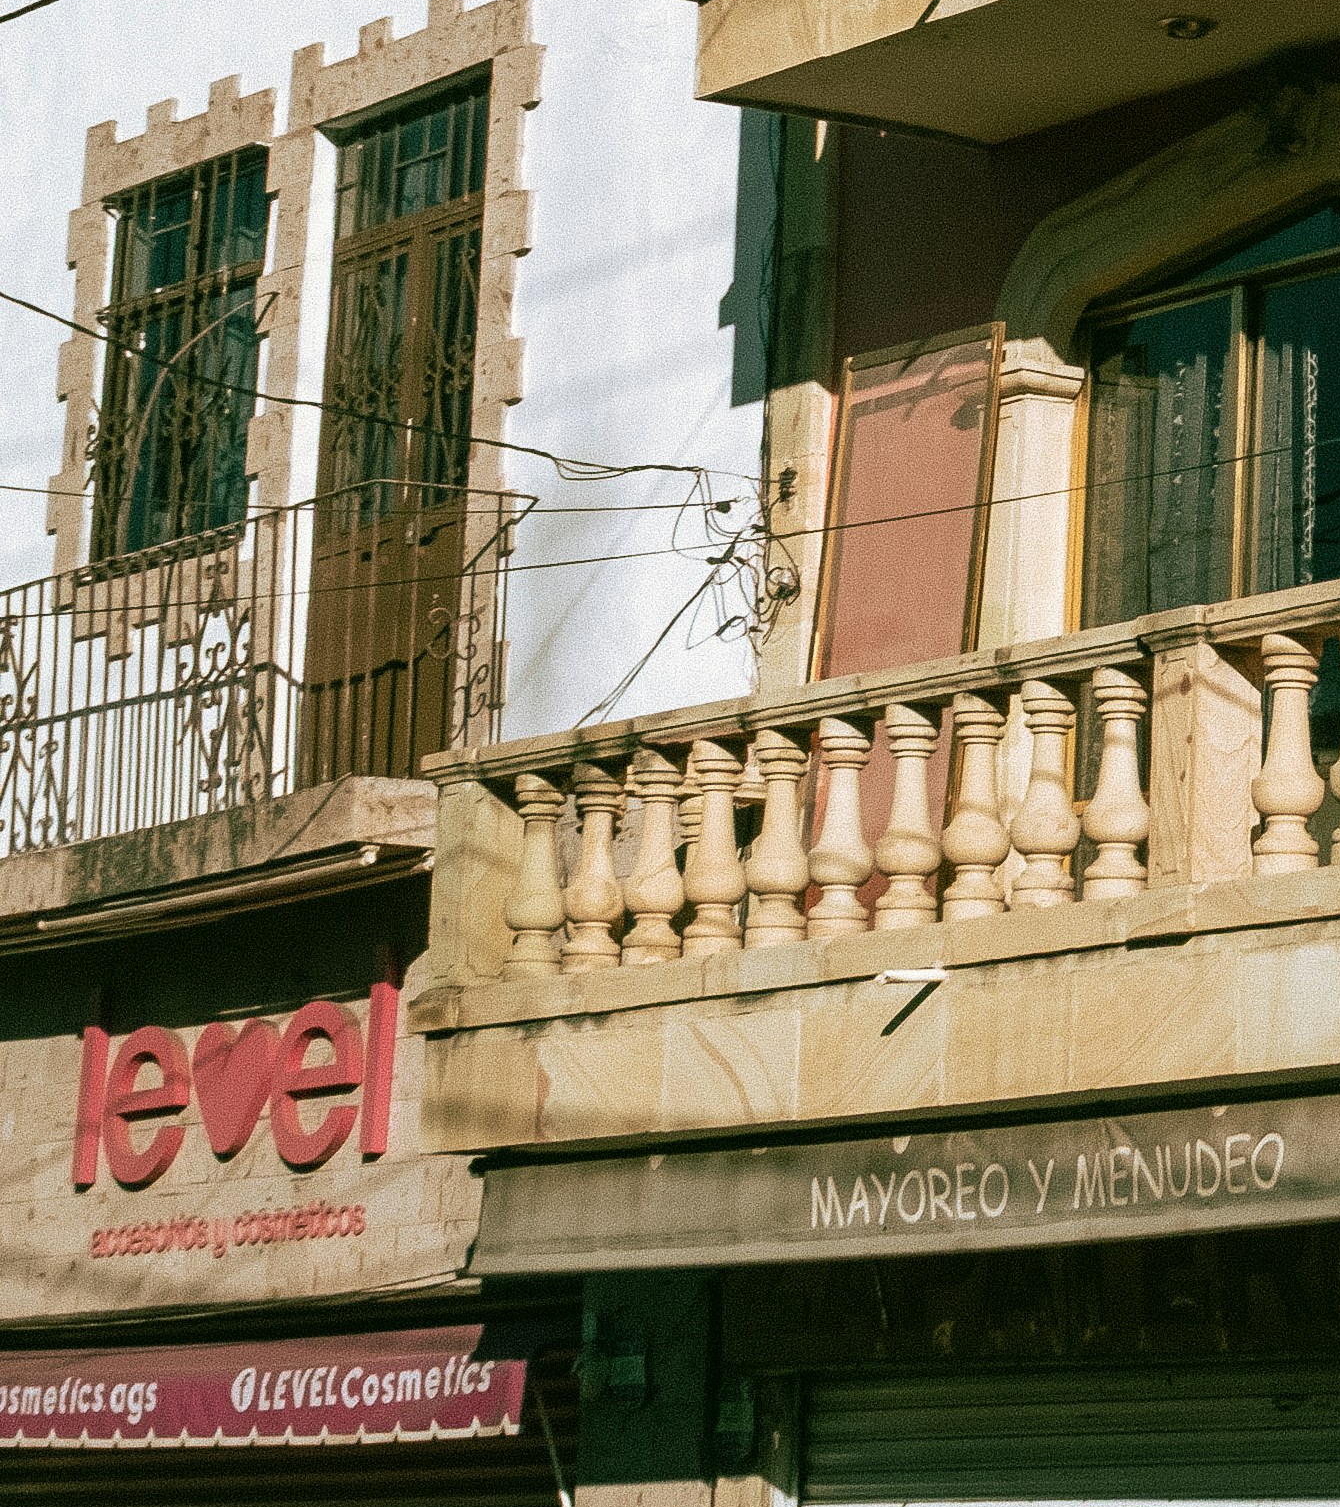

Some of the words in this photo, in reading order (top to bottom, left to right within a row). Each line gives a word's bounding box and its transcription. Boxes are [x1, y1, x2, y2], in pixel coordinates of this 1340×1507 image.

[810, 1162, 1009, 1230] MAYOREO
[1028, 1159, 1055, 1214] Y
[1074, 1132, 1286, 1210] MENUDEO
